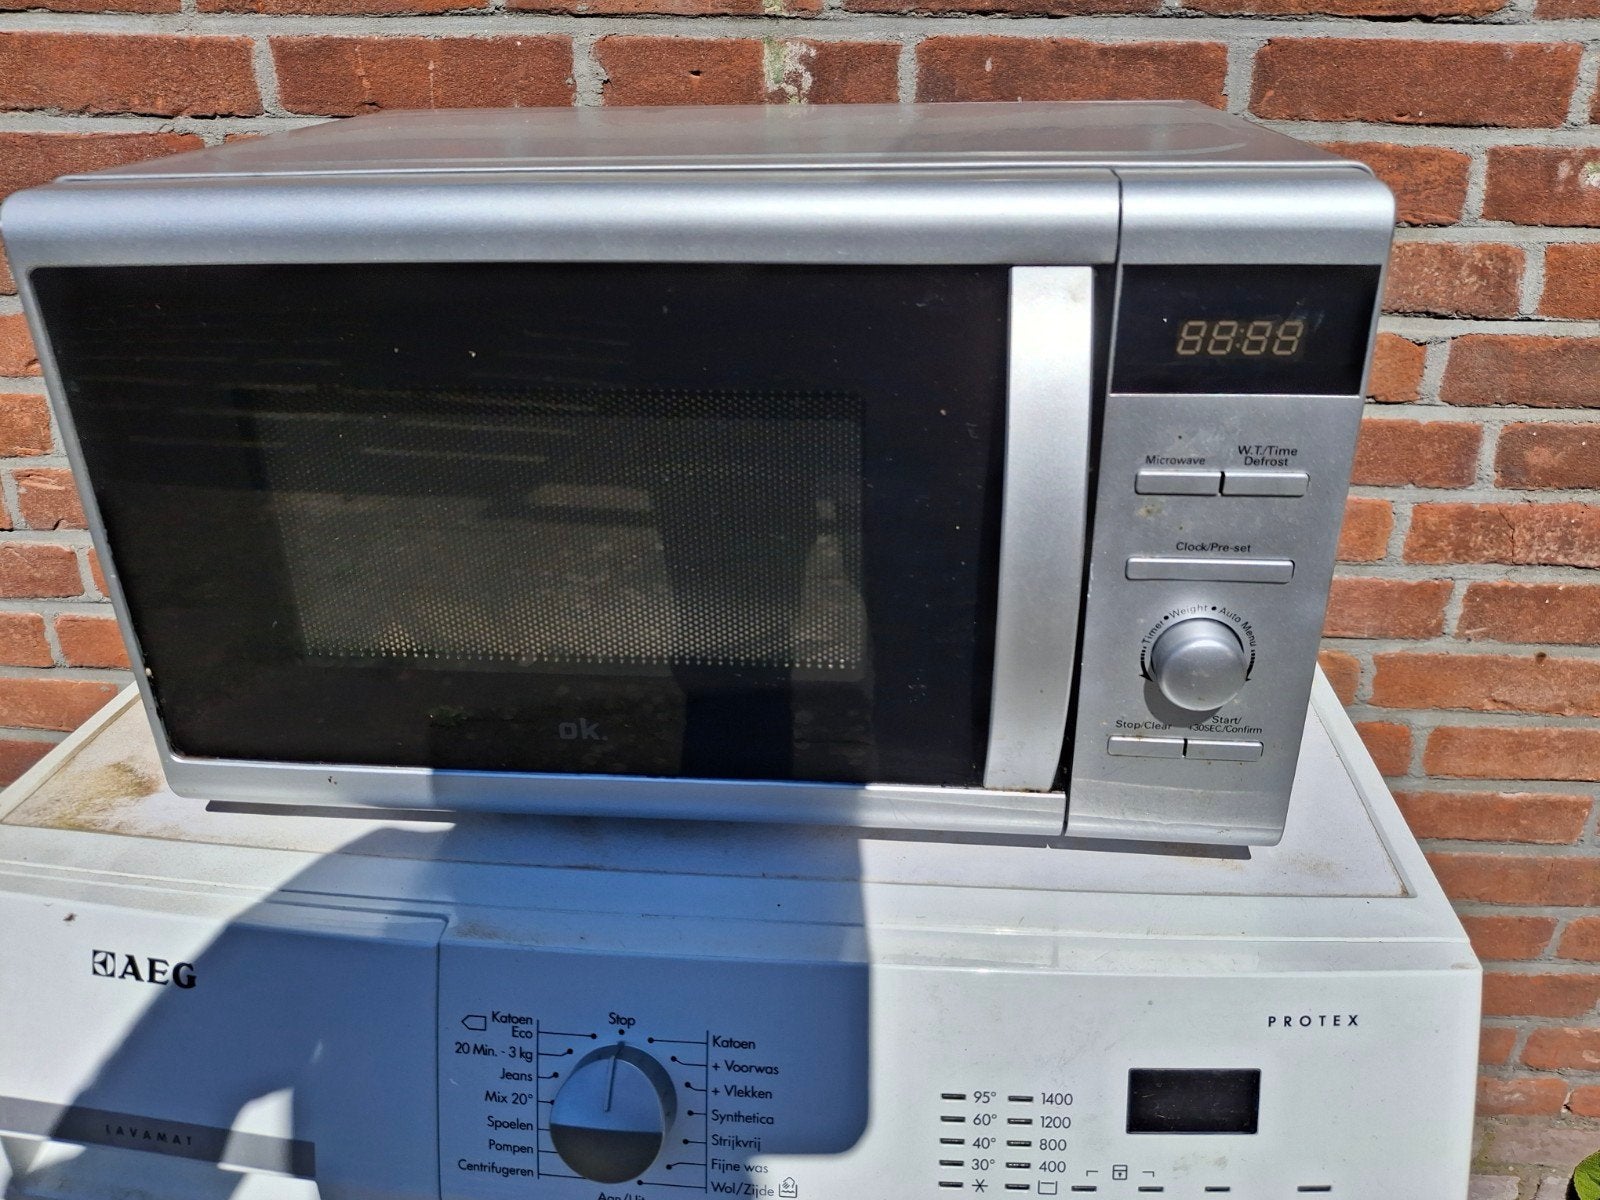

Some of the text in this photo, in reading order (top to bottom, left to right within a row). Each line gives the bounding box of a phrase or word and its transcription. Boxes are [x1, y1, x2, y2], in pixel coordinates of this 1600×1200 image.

[1176, 320, 1304, 355] 88:88
[1145, 455, 1206, 466] Microwave
[1244, 456, 1288, 467] Defrost
[1176, 541, 1251, 553] Clock/Pre-set
[1141, 604, 1257, 647] Timer Weight Auto Menu
[1115, 719, 1172, 730] Stop/Clear
[1212, 715, 1242, 725] Start/
[118, 953, 197, 989] AEG
[491, 1010, 533, 1025] Katoen
[608, 1012, 636, 1029] Stop
[1267, 1014, 1359, 1028] PROTEX
[511, 1026, 533, 1039] Eco
[712, 1034, 756, 1050] Katoen
[454, 1042, 470, 1054] 20
[473, 1043, 498, 1057] Min.
[508, 1047, 516, 1058] 3
[519, 1048, 533, 1063] kg
[500, 1067, 533, 1082] Jeans
[724, 1059, 779, 1075] Voorwas
[484, 1090, 533, 1105] Mix 20°
[723, 1084, 773, 1100] Vlekken
[973, 1090, 997, 1104] 95°
[1040, 1092, 1073, 1106] 1400
[487, 1115, 534, 1132] Spoelen
[711, 1108, 775, 1126] Synthetica
[972, 1113, 998, 1127] 60°
[1040, 1115, 1072, 1130] 1200
[105, 1123, 193, 1146] LAVAMAT
[488, 1138, 534, 1155] Pompen
[711, 1133, 761, 1152] Strijkvrij
[972, 1137, 997, 1150] 40°
[1038, 1138, 1068, 1152] 800
[457, 1158, 534, 1177] Centrifugeren
[711, 1158, 769, 1174] Fijne was
[970, 1158, 996, 1171] 30°
[1038, 1160, 1067, 1173] 400
[711, 1181, 775, 1199] Wol/Zijde
